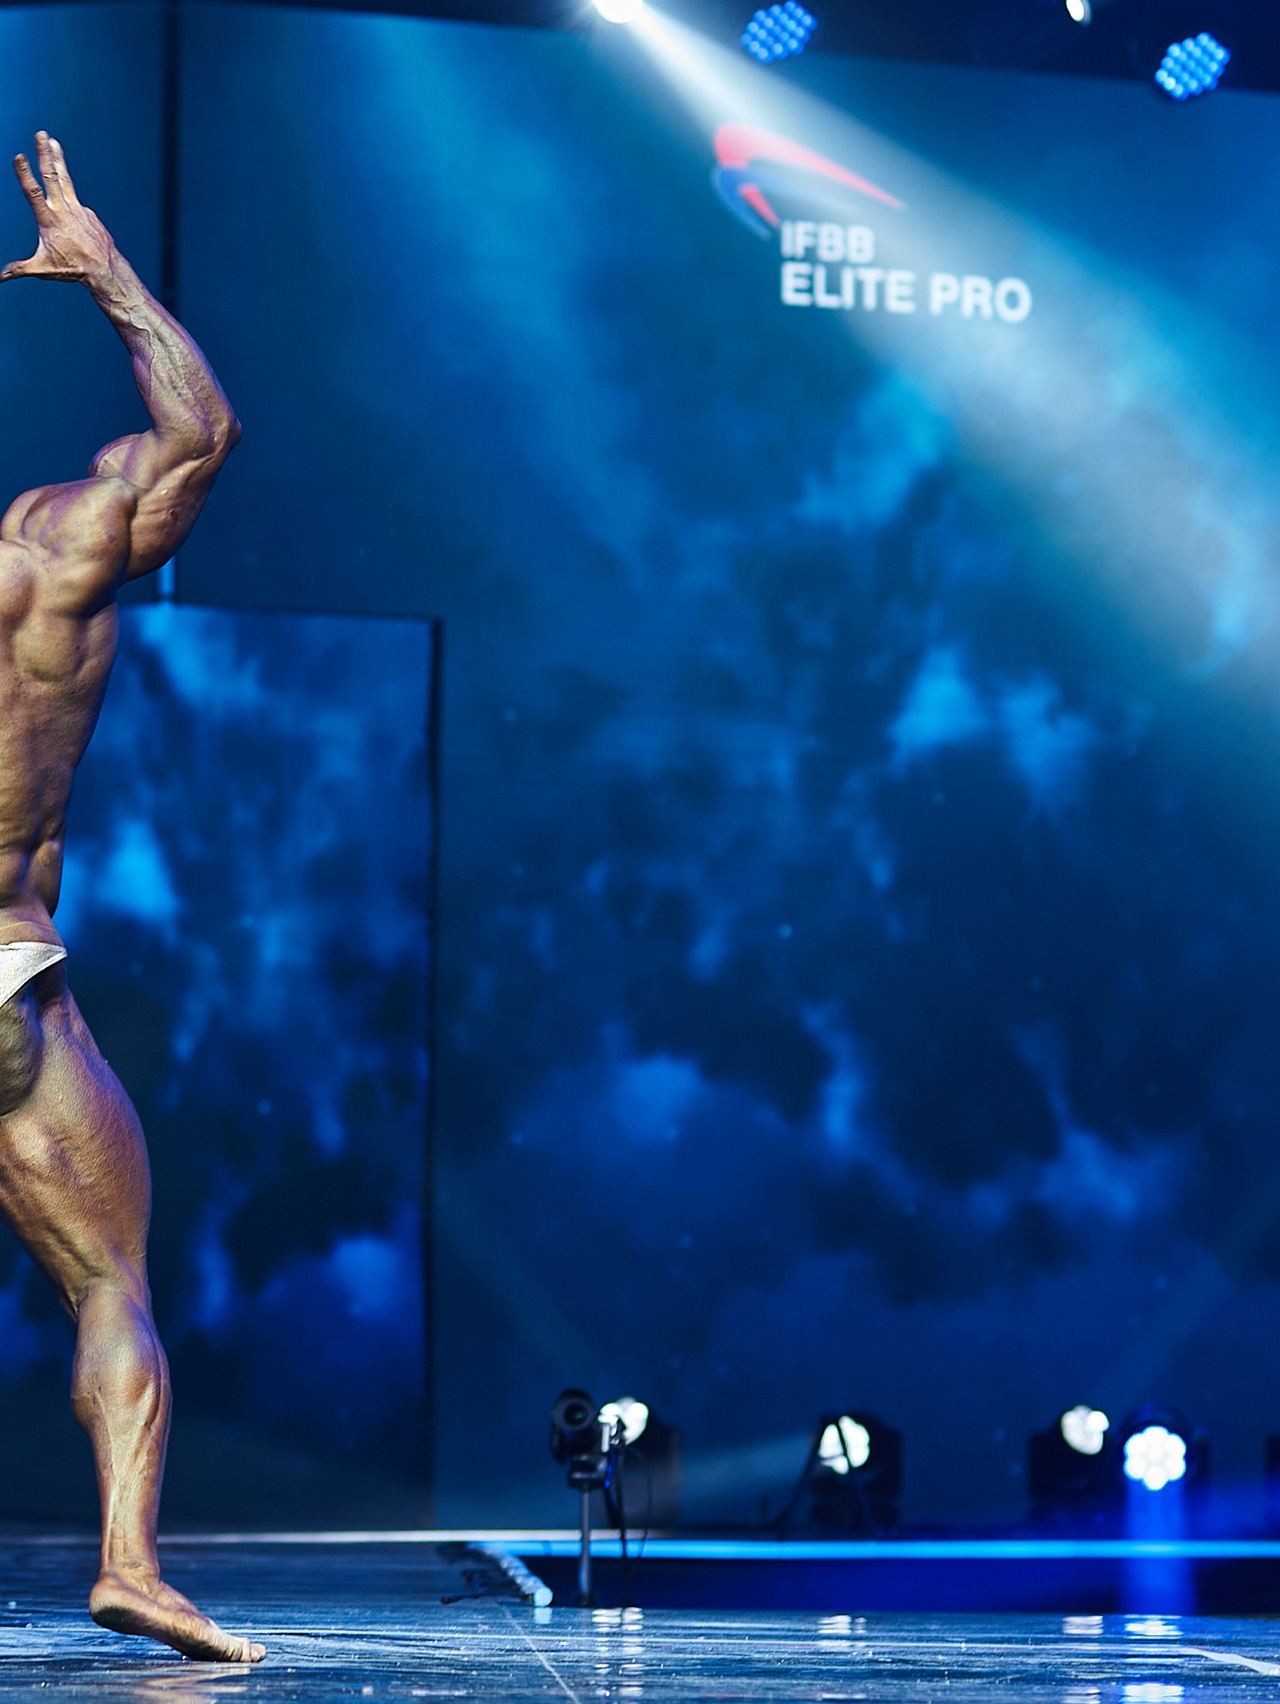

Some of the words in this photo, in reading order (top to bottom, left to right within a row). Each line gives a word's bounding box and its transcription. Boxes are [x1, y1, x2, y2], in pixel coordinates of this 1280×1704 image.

[780, 220, 875, 264] IFBB
[781, 262, 916, 314] ELITE
[928, 272, 1032, 323] PRO
